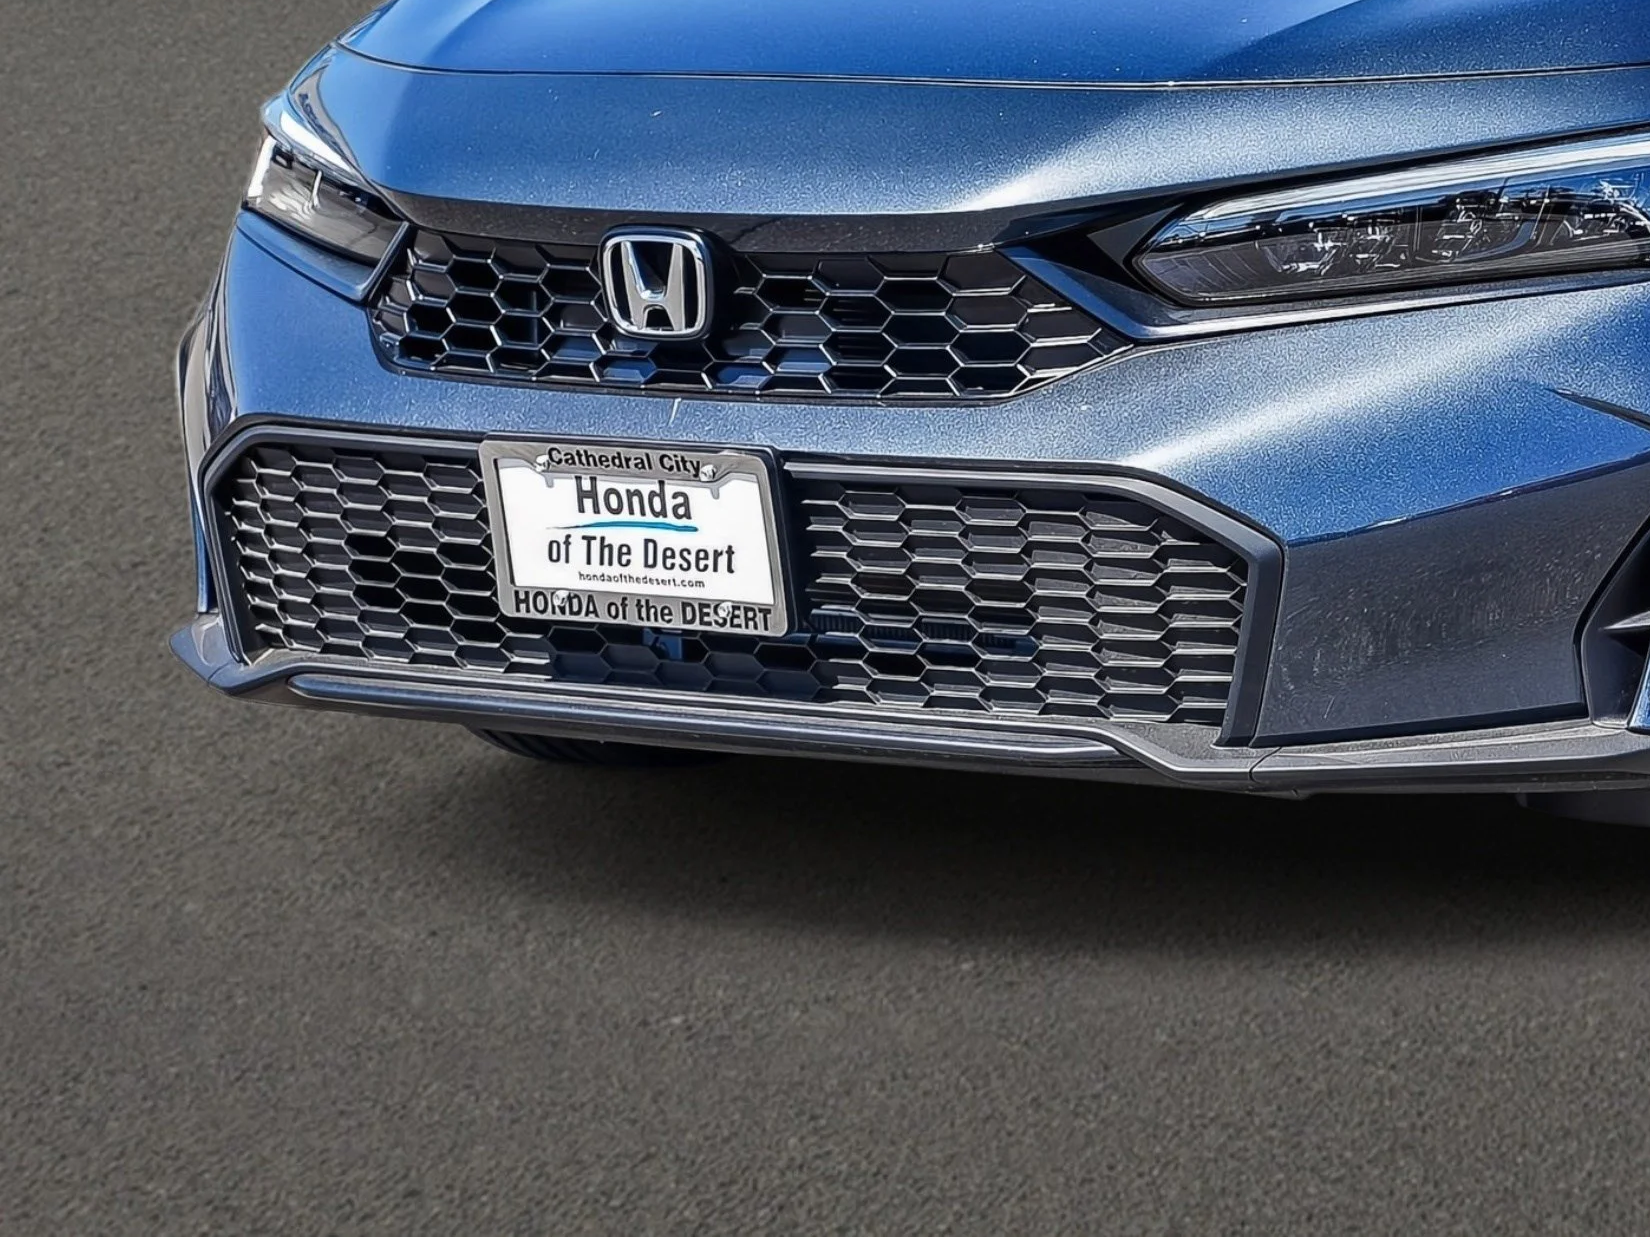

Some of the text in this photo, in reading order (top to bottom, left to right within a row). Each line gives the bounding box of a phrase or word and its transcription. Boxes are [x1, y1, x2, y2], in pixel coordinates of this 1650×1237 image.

[547, 447, 701, 477] Cathedral City
[573, 475, 692, 520] Honda
[549, 535, 735, 574] of The Desert
[578, 571, 706, 588] hondaofthedesert.com
[513, 590, 772, 632] HONDA of the DESERT
